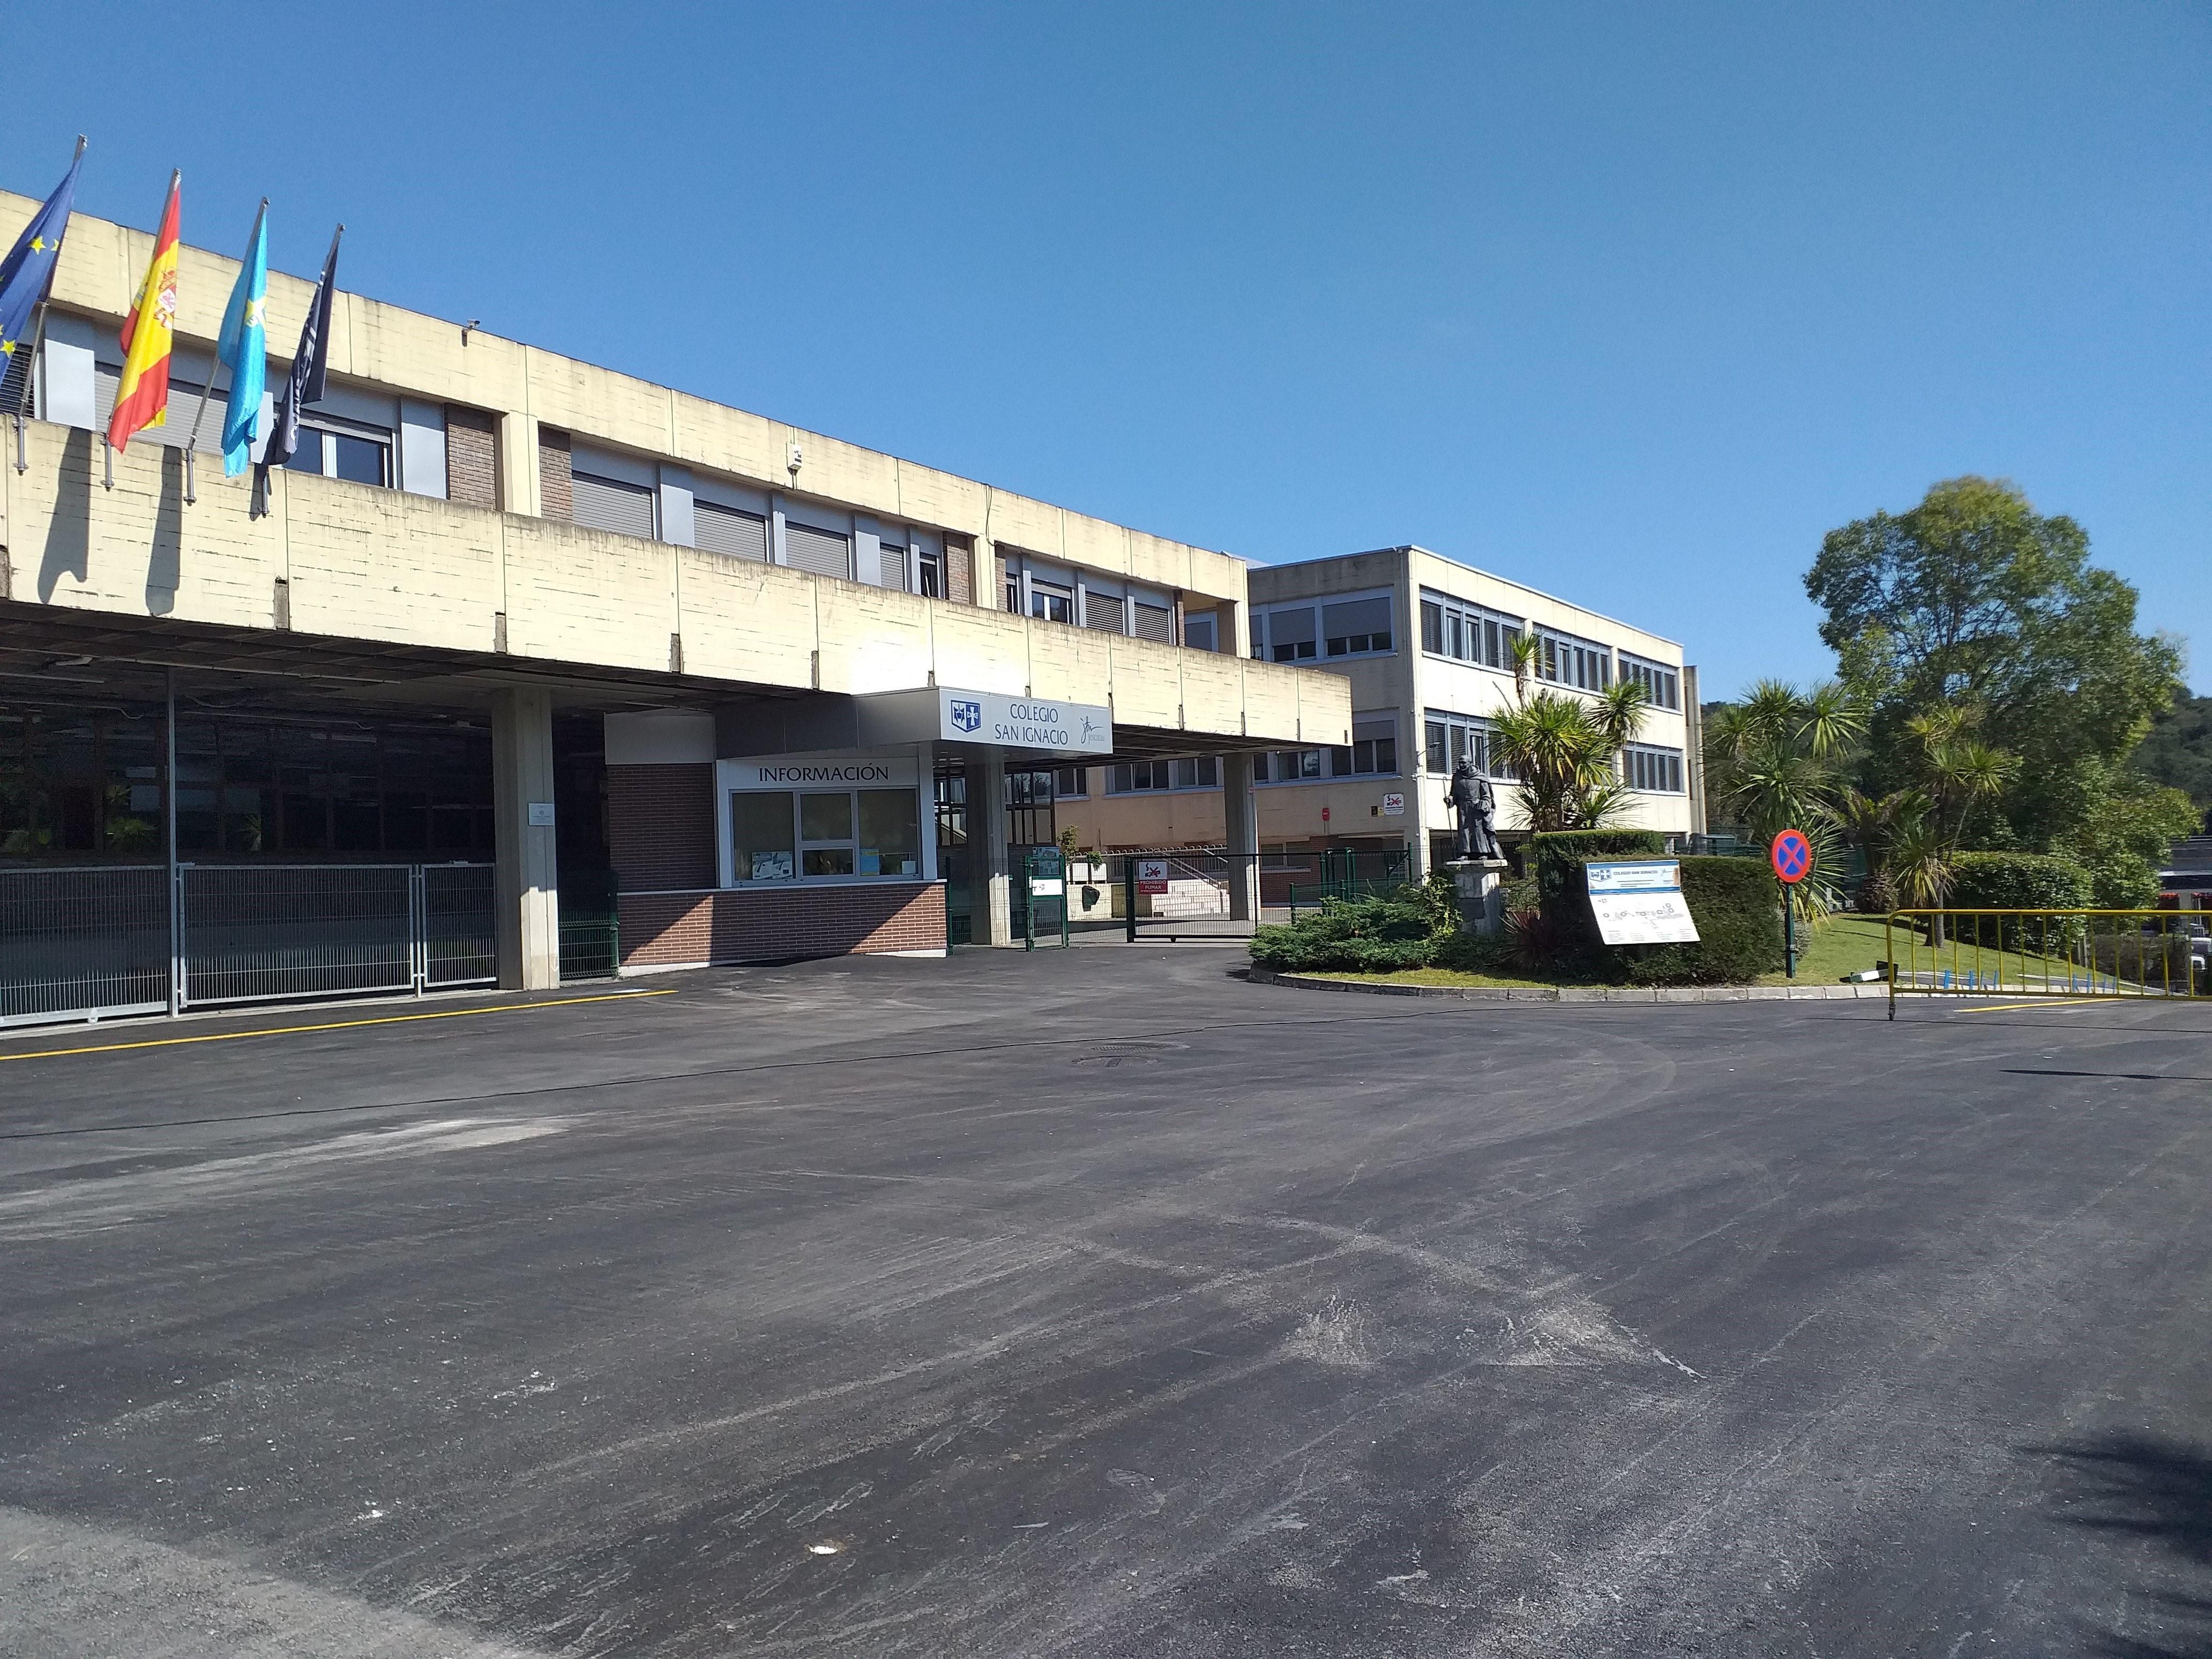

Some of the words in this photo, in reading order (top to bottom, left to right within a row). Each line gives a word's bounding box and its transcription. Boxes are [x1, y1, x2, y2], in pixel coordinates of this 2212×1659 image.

[1010, 704, 1058, 723] COLEGIO
[995, 724, 1019, 741] SAN
[1022, 727, 1068, 745] IGNACIO
[759, 763, 888, 782] INFORMACIÓN
